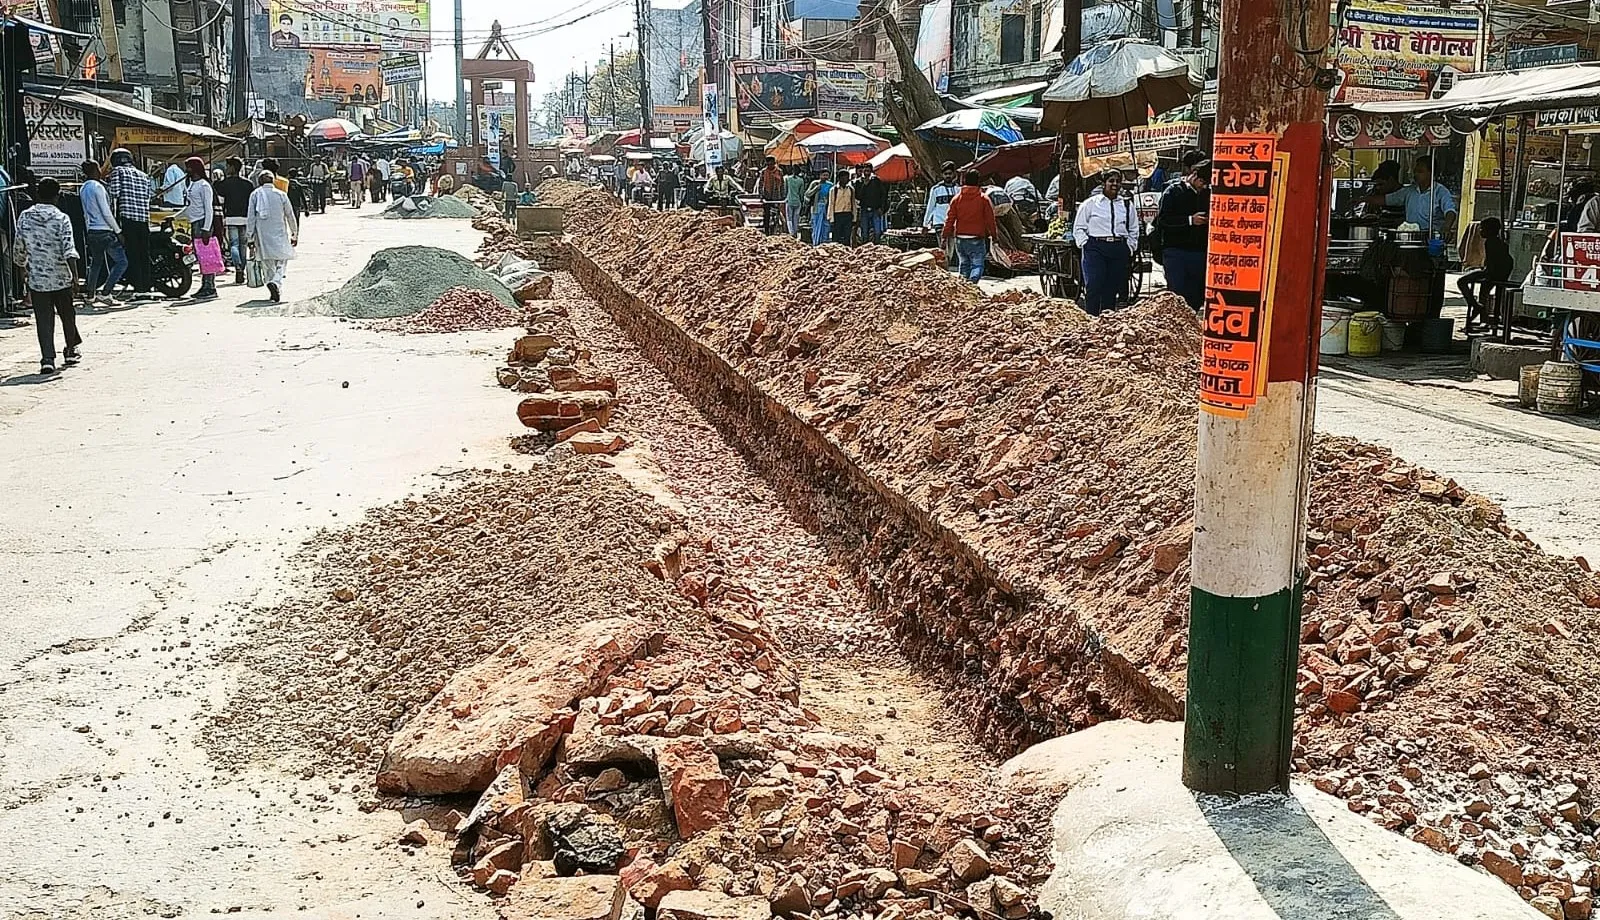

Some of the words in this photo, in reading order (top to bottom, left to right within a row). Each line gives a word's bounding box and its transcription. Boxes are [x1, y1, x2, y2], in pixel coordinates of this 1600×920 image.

[1339, 25, 1364, 48] श्री
[1409, 30, 1476, 56] बैंगिल्स
[1262, 144, 1270, 155] ?
[1222, 162, 1268, 187] रोग
[1249, 198, 1265, 214] ठीक
[1205, 292, 1254, 337] देव
[1204, 340, 1234, 353] तवार
[1218, 358, 1250, 372] फाटक
